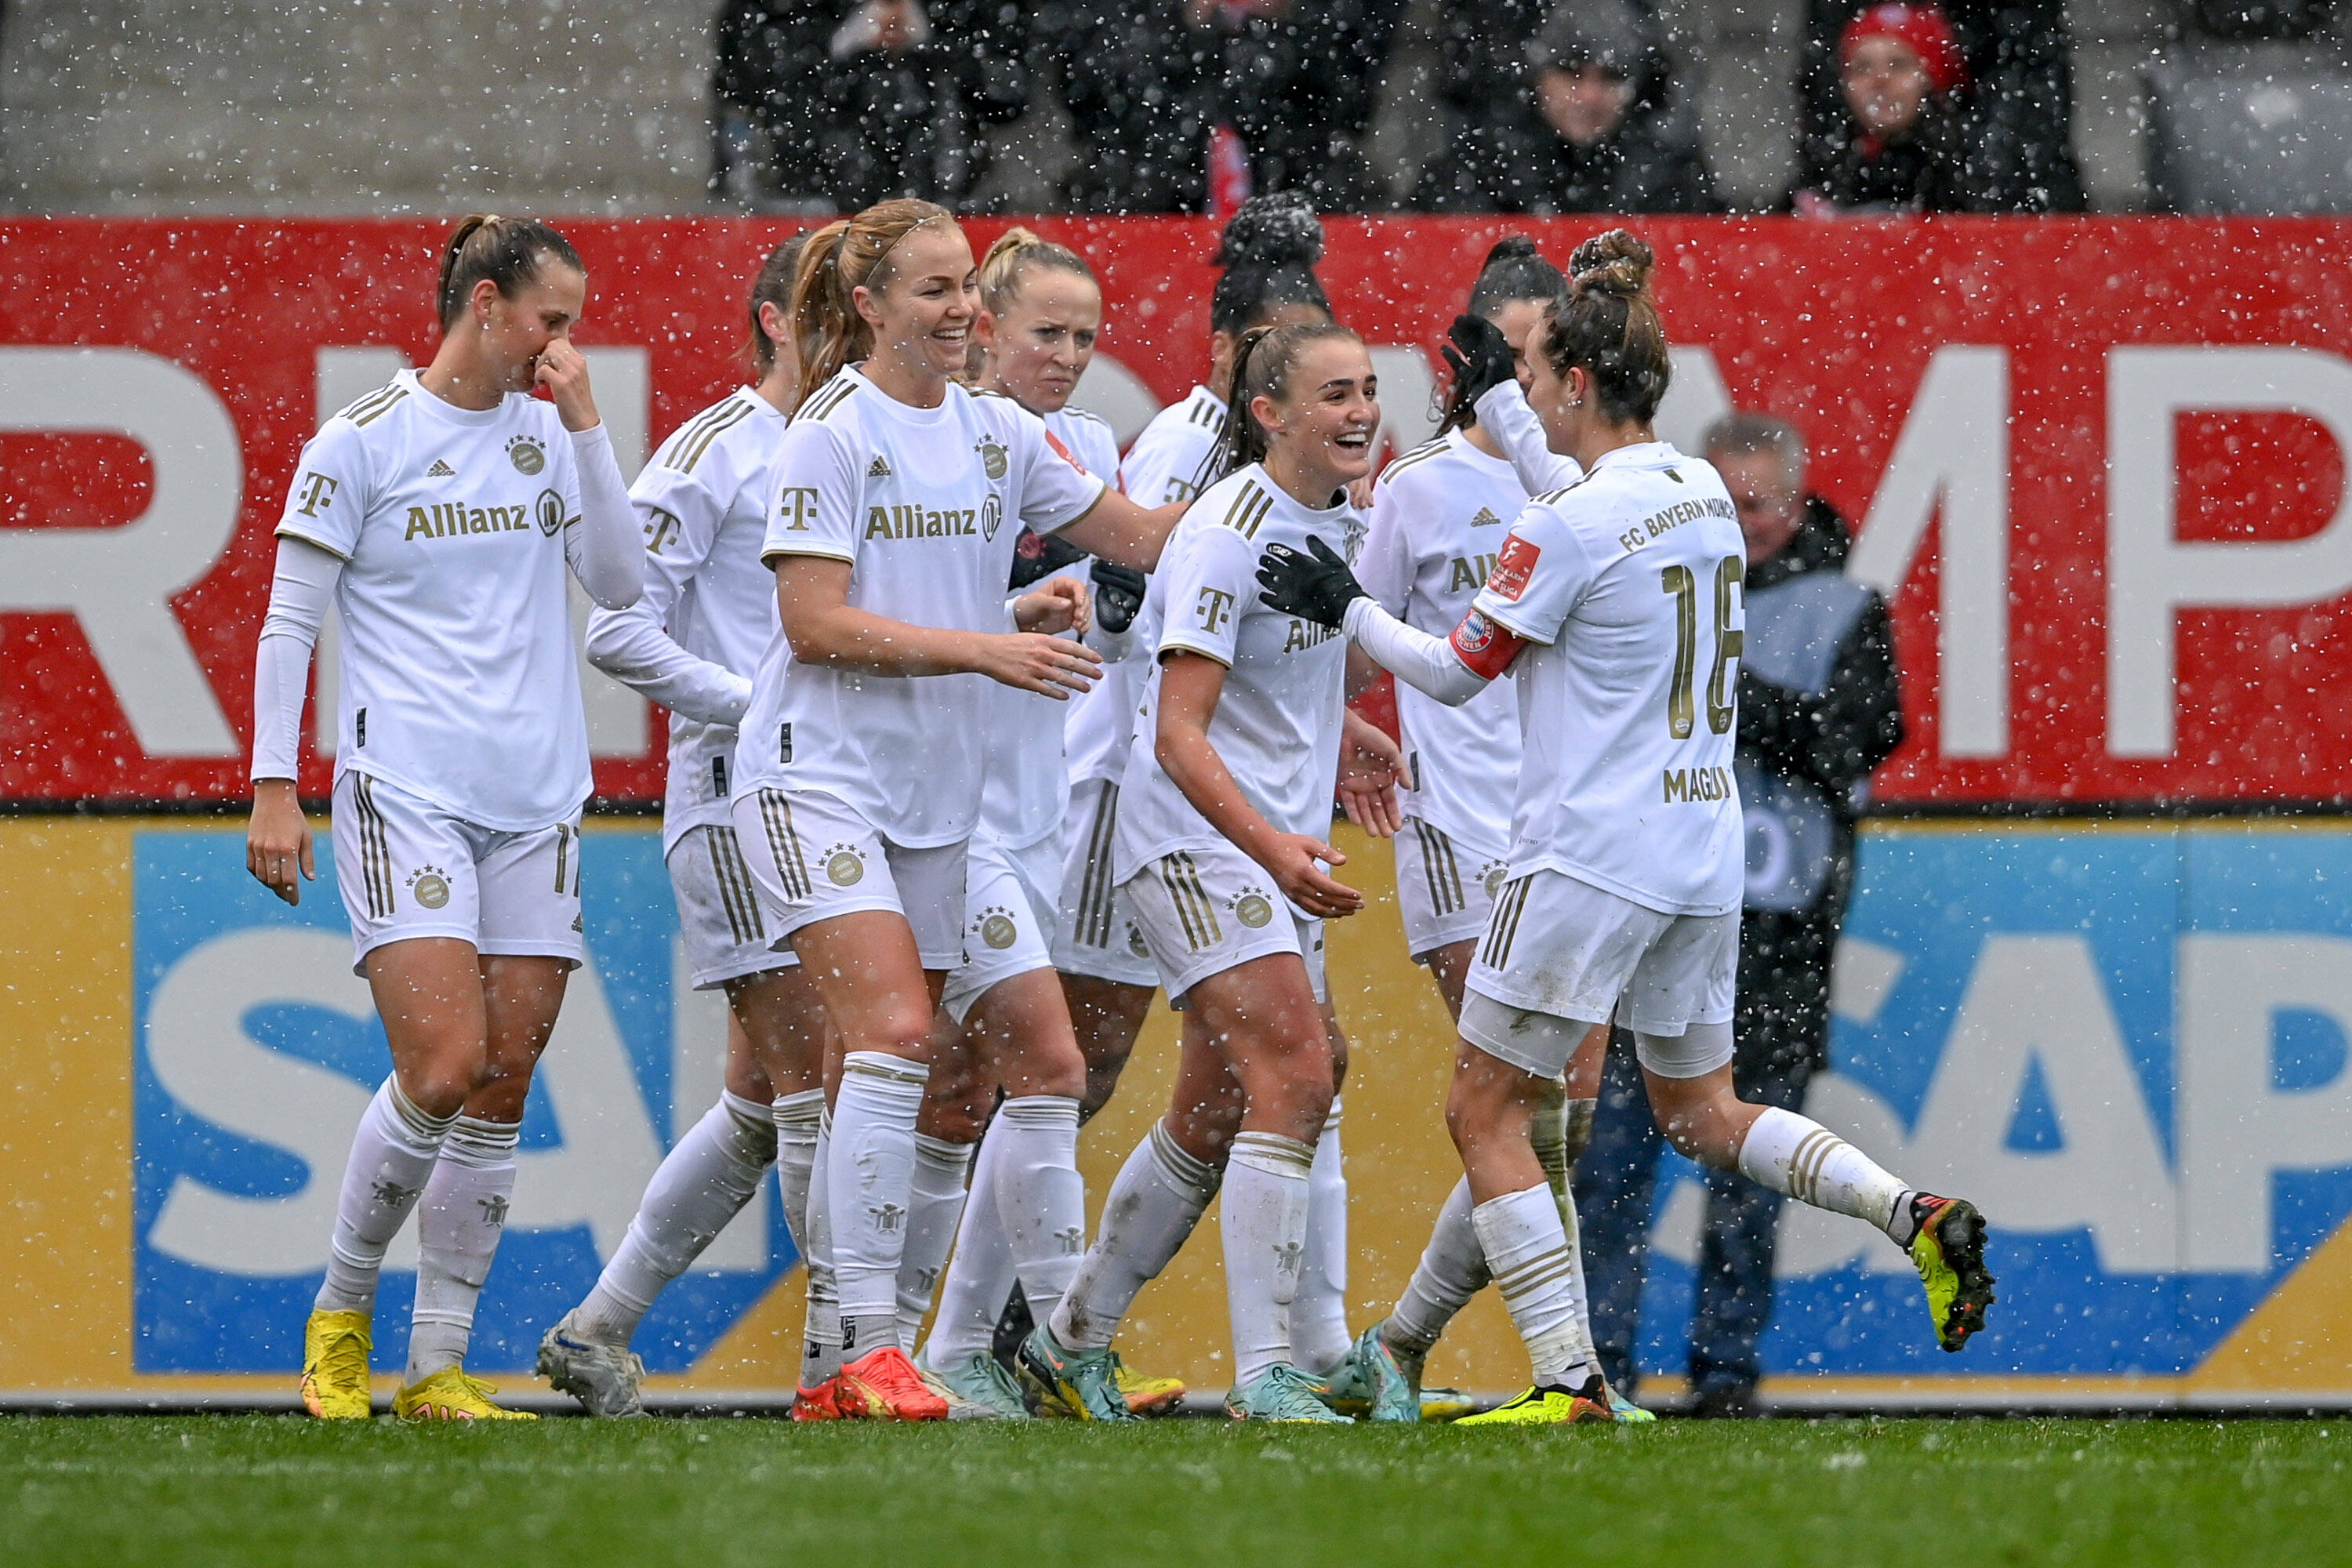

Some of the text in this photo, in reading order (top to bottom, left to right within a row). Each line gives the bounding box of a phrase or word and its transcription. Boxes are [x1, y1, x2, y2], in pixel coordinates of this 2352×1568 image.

[297, 471, 338, 518] T
[781, 487, 818, 531] T
[405, 502, 530, 542] Allianz
[644, 506, 681, 556] T
[865, 504, 977, 540] Allianz
[1619, 527, 1646, 552] FC
[1644, 499, 1706, 538] BAYERN
[1451, 553, 1497, 593] All
[1196, 586, 1234, 635] T
[1661, 554, 1745, 739] 16
